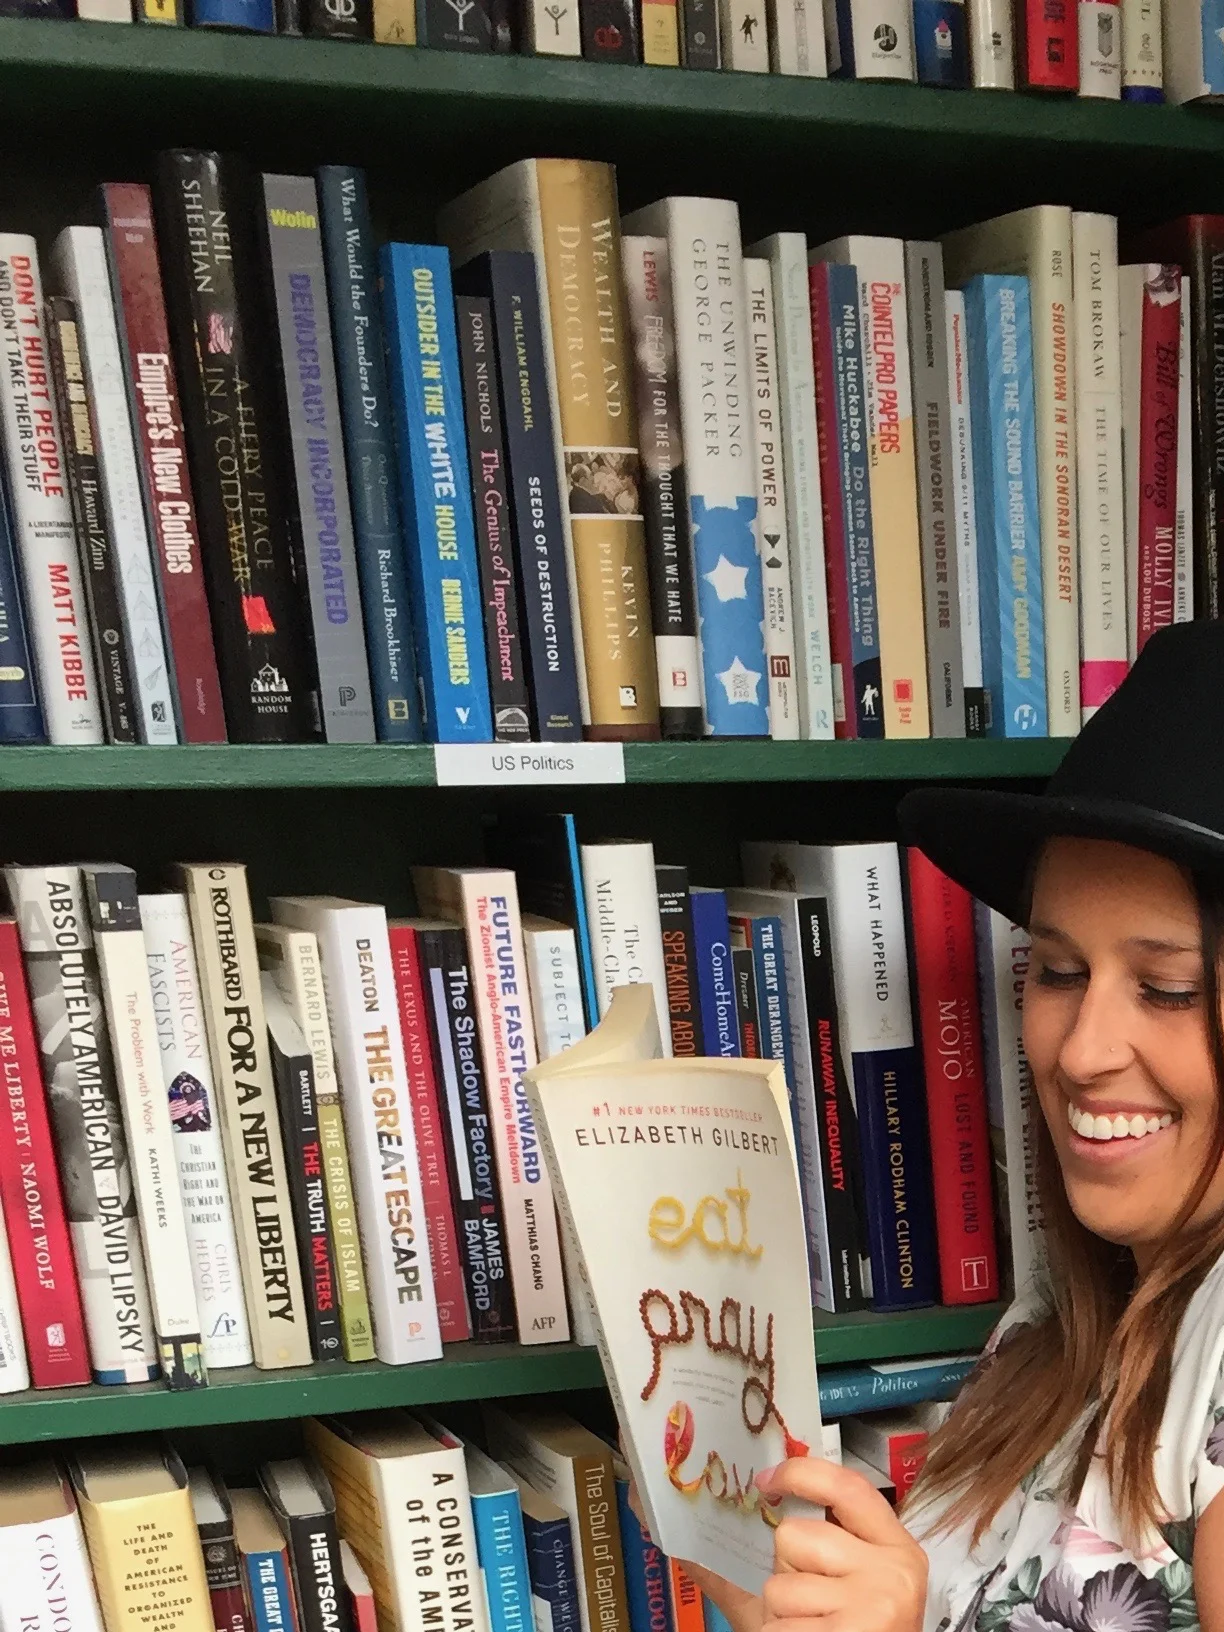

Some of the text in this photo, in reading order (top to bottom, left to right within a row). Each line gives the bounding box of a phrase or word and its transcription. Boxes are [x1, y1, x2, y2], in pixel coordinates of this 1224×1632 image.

[269, 209, 316, 230] Wolin
[11, 256, 63, 498] DON'T HURT PEOPLE
[529, 477, 559, 672] SEEDS OF DESTRUCTION
[48, 565, 88, 702] MATT KIBBE
[251, 695, 292, 704] RANDOM
[257, 705, 289, 714] HOUSE
[492, 756, 574, 771] US Politics
[211, 887, 242, 1001] ROTHBARD
[867, 866, 888, 1002] WHAT HAPPENED
[355, 939, 379, 1012] DEATON
[46, 879, 115, 1172] ABSOLUTELY AMERICAN
[938, 999, 962, 1080] MOJO
[447, 966, 495, 1200] The Shadow Factory
[592, 1103, 763, 1122] #1 NEW YORK TIMES BESTSELLER
[817, 1020, 845, 1191] RUNAWAY INEQUALITY
[225, 1004, 294, 1324] FOR A NEW LIBERTY
[363, 1025, 423, 1305] THE GREAT ESCAPE
[575, 1127, 779, 1155] ELIZABETH GILBERT
[649, 1167, 763, 1261] eat
[884, 1072, 913, 1289] HILLARY RODHAM CLINTON
[99, 1196, 144, 1352] DAVID LIPSKY
[464, 1220, 490, 1310] BAMFORD
[481, 1217, 504, 1280] JAMES
[531, 1316, 557, 1331] AFP
[639, 1289, 775, 1434] pray
[406, 1500, 429, 1525] of
[432, 1473, 453, 1487] A
[125, 1575, 188, 1591] RESISTANCE
[126, 1565, 183, 1580] AMERICAN
[411, 1537, 433, 1579] the
[128, 1597, 193, 1613] ORGANIZED
[141, 1610, 184, 1623] WEALTH
[153, 1623, 176, 1632] AND
